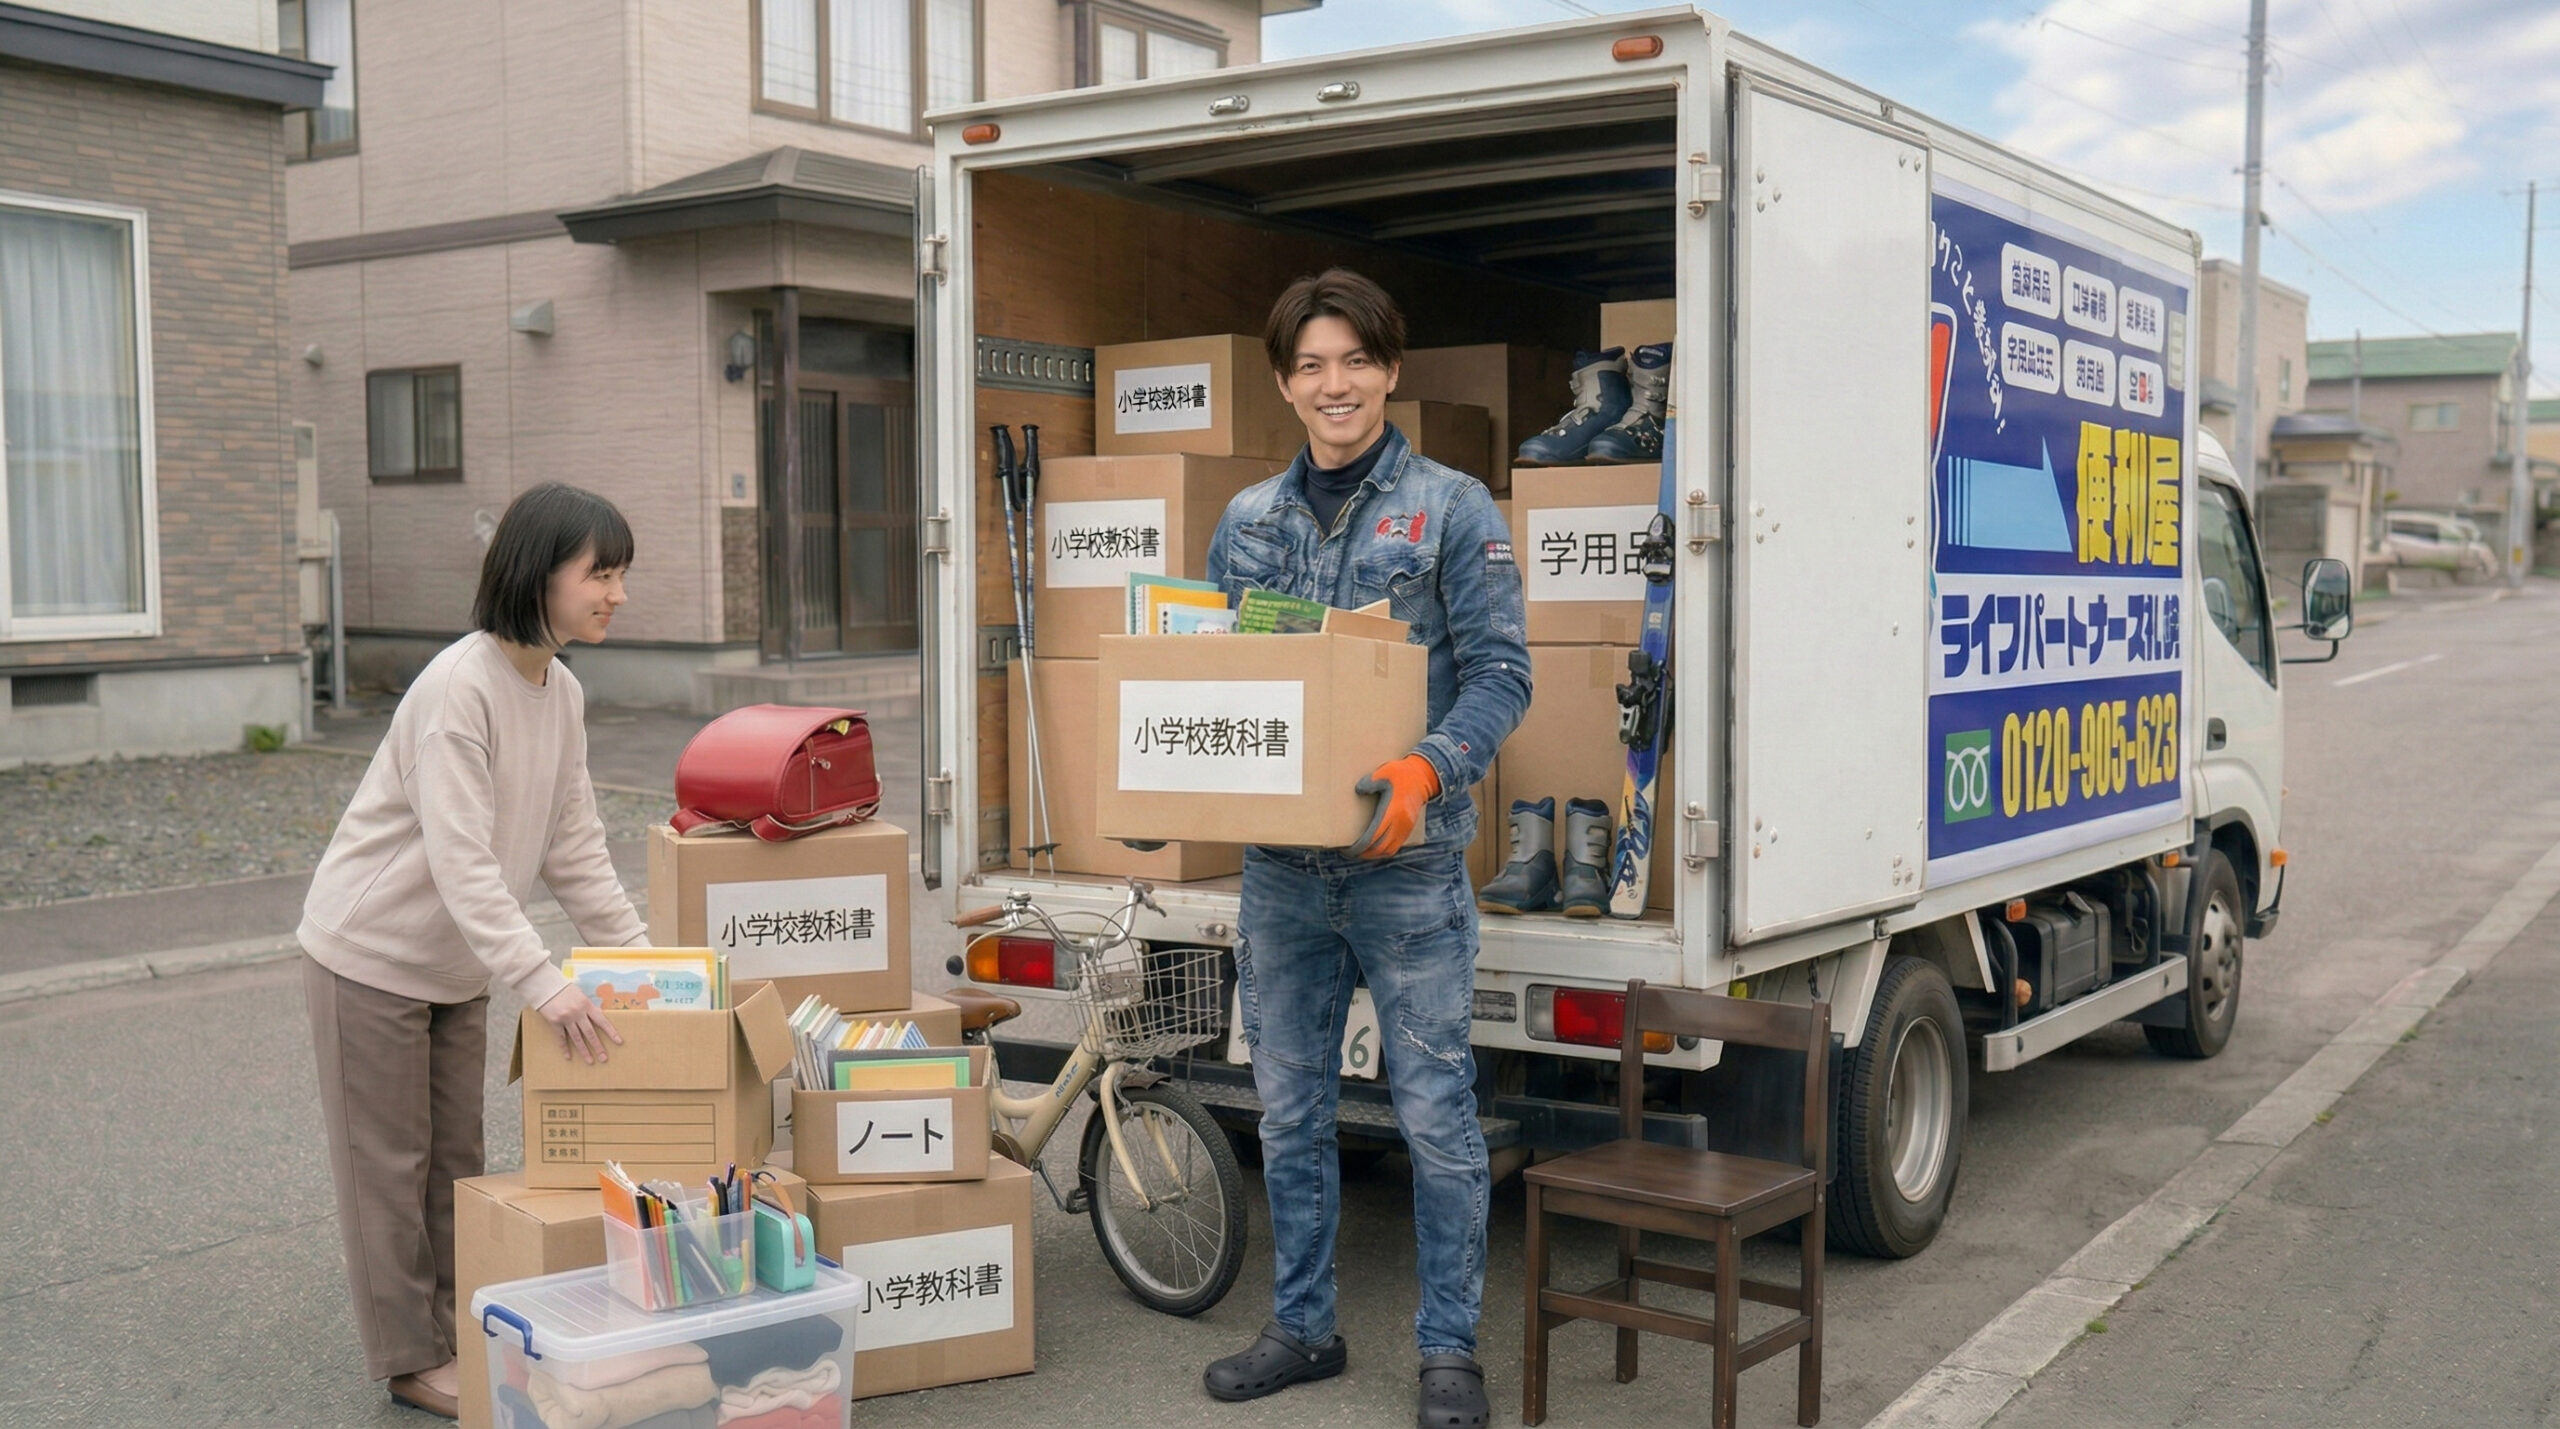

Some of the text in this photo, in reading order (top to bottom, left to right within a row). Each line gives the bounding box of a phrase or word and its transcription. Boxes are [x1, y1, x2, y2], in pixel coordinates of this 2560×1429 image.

[1118, 382, 1207, 414] 小学校教科書
[2076, 420, 2180, 567] 便利屋
[1051, 525, 1160, 559] 小学校教科書
[1134, 716, 1290, 757] 小学校教科書
[2002, 692, 2177, 818] 0120-905-623
[721, 907, 876, 948] 小学校教科書
[1348, 1024, 1371, 1069] 6
[848, 1118, 945, 1156] ノート
[861, 1262, 1003, 1314] 小学教科書
